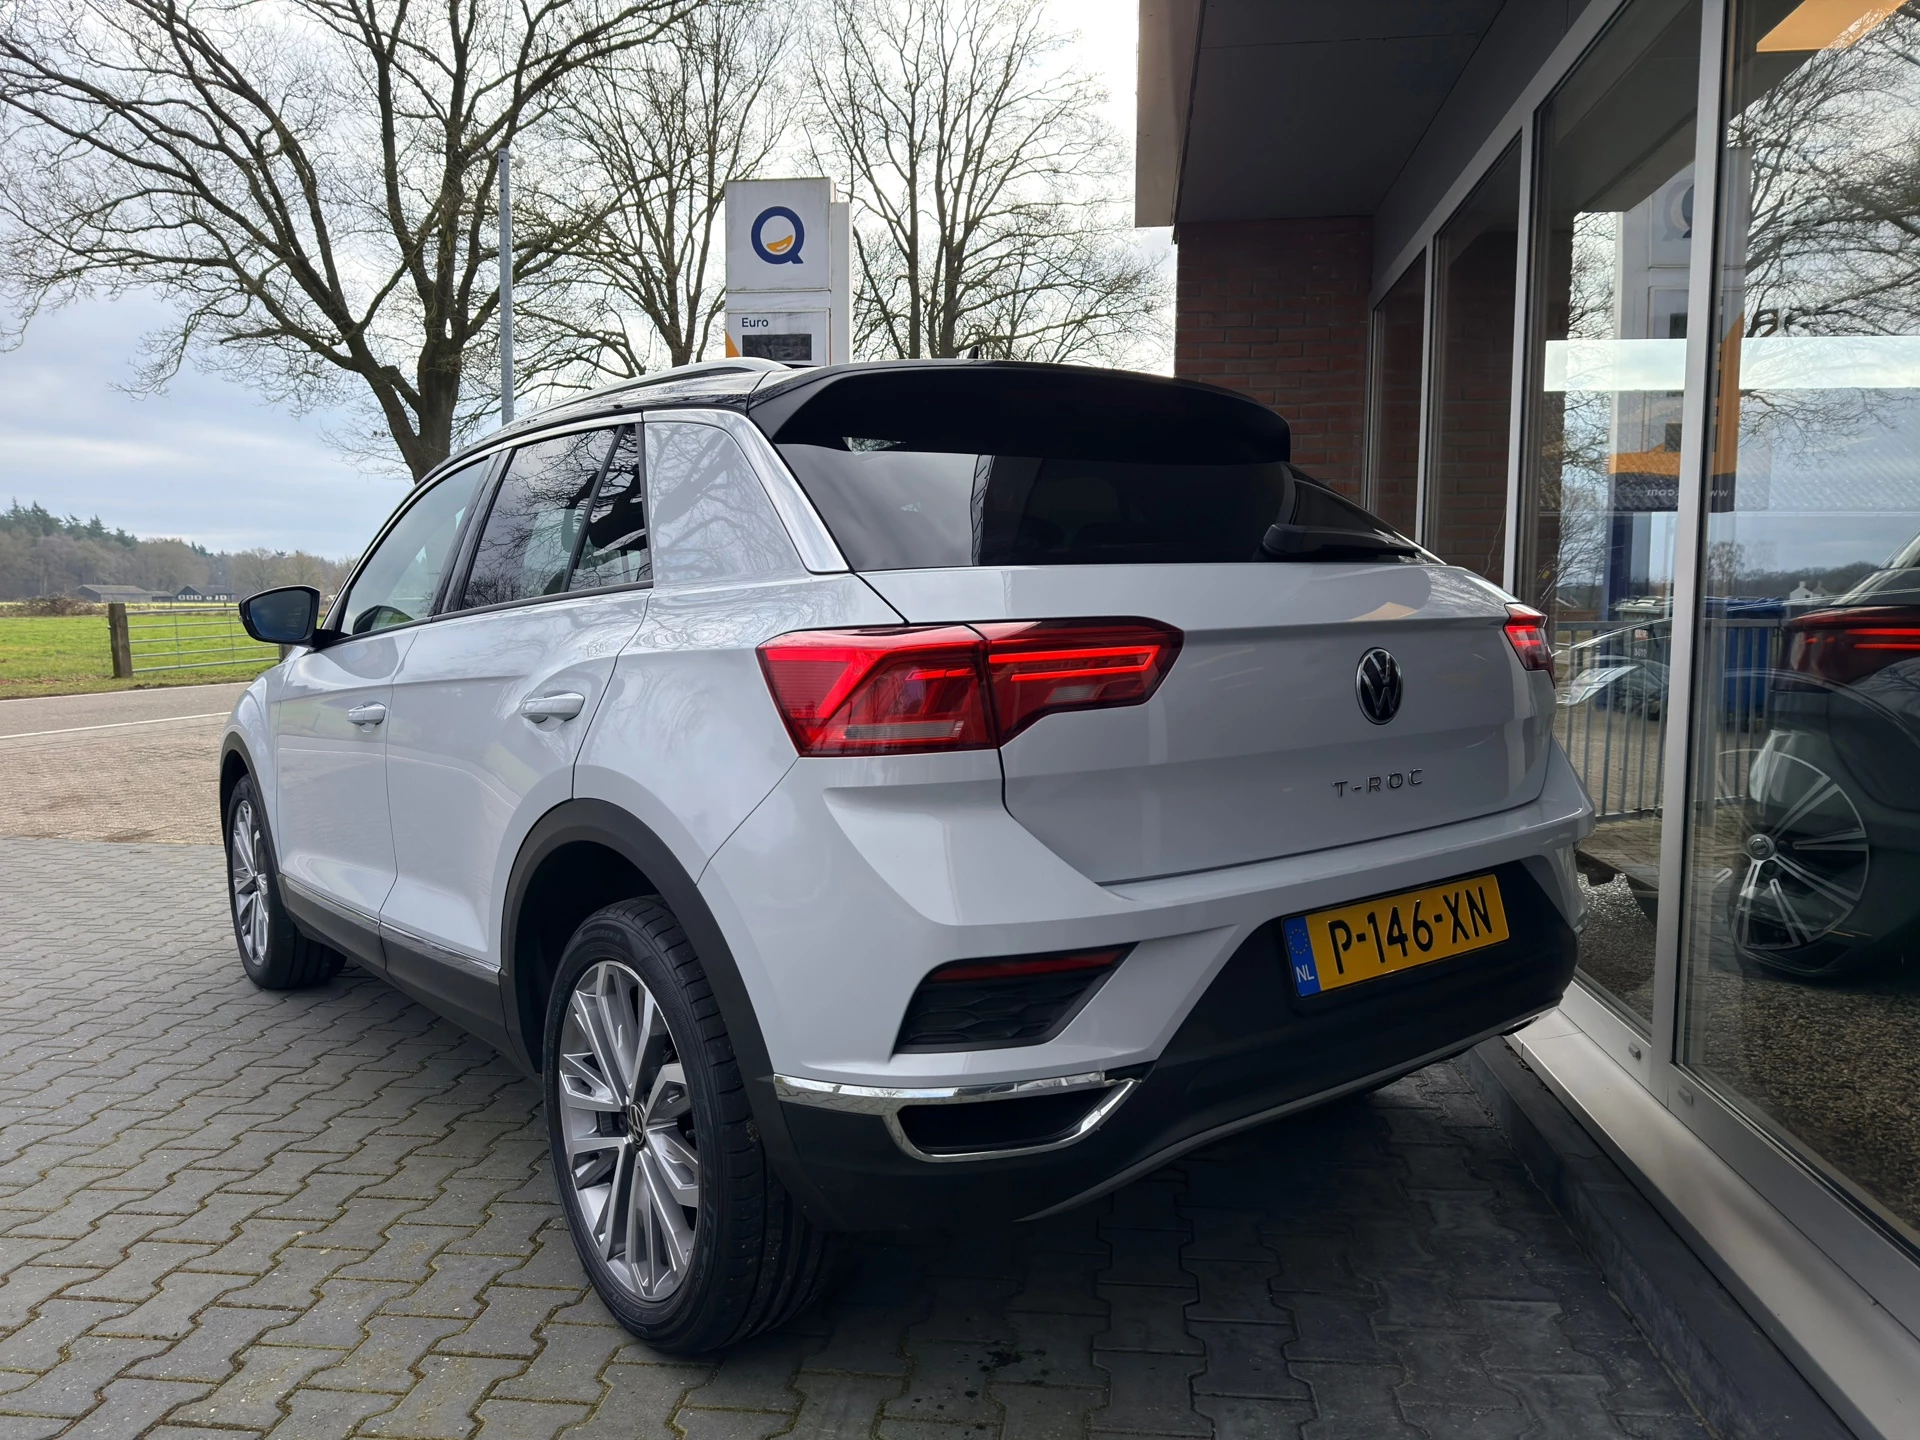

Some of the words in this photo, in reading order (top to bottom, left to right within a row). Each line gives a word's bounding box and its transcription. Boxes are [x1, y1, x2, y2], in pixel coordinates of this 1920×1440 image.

[750, 206, 805, 264] Q
[741, 317, 769, 328] Euro
[1357, 648, 1402, 722] VW
[1332, 768, 1424, 797] T-ROC
[1328, 886, 1492, 975] P-146-XN
[1295, 964, 1315, 983] NL
